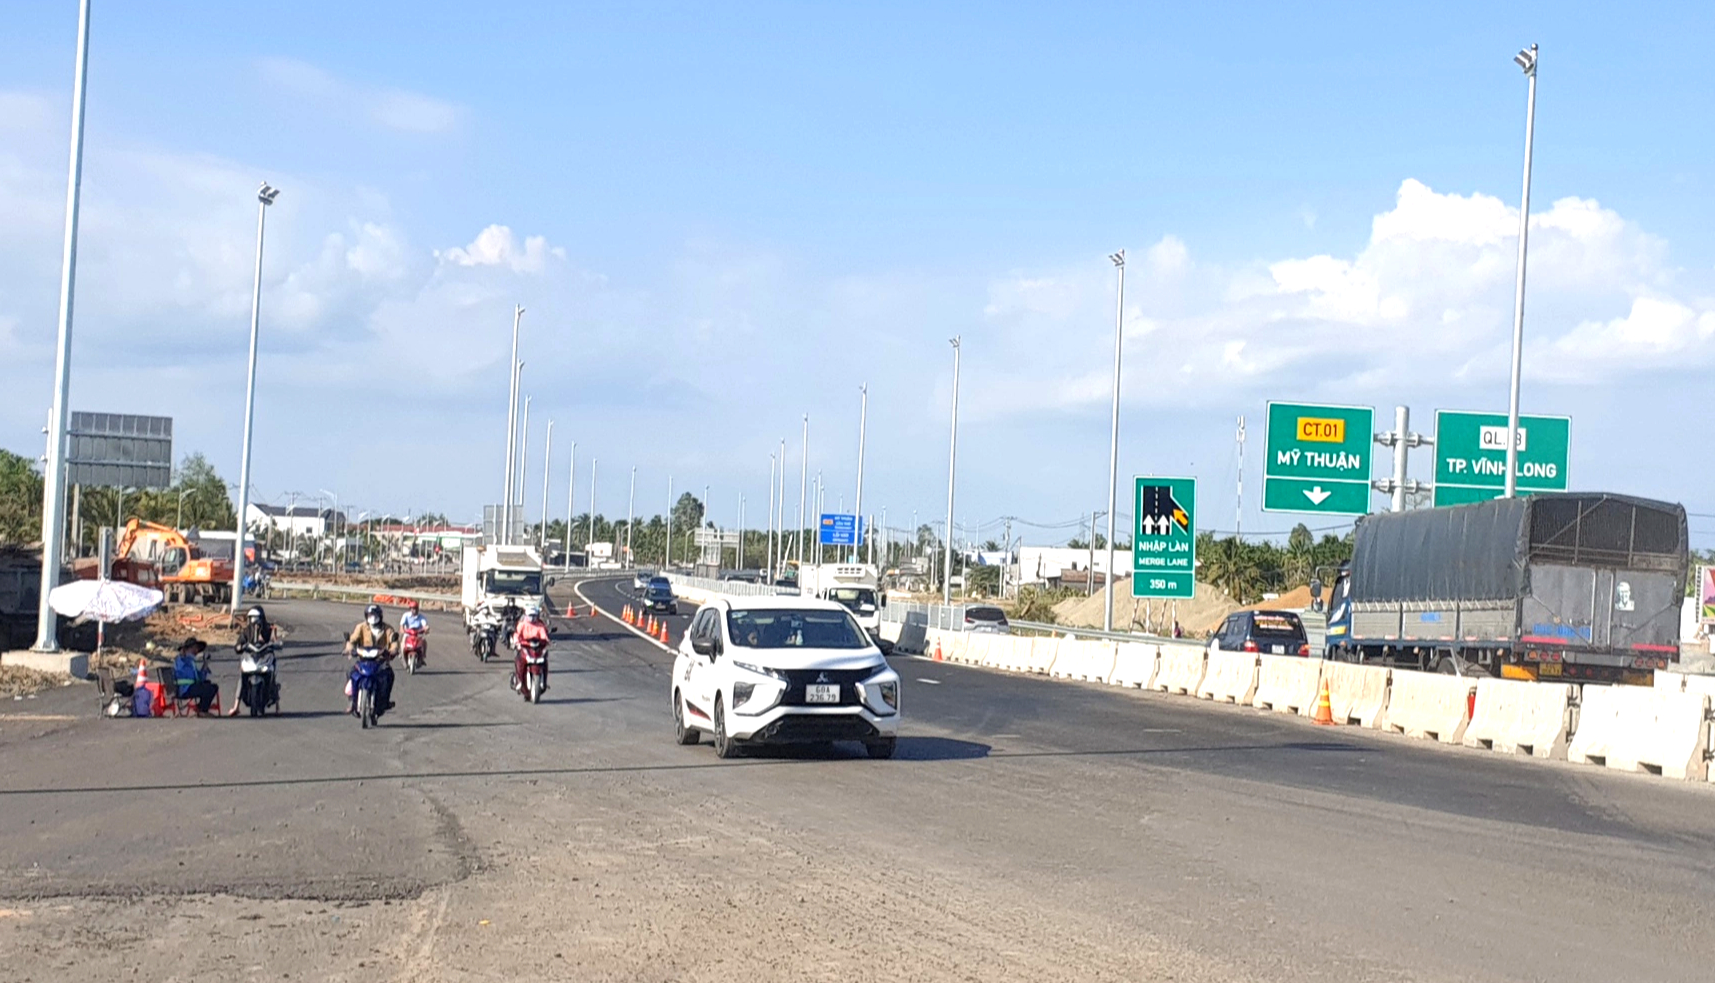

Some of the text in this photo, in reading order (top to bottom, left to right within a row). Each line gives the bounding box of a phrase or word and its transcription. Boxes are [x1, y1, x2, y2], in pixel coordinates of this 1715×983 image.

[1303, 422, 1338, 438] CT.01
[1277, 448, 1360, 471] MỸ THUẬN
[1446, 457, 1467, 474] TP.
[1515, 461, 1557, 478] LONG
[1138, 539, 1188, 553] NHẬP LÀN
[1138, 557, 1188, 567] MERGE LANE
[1149, 578, 1177, 590] 350 m
